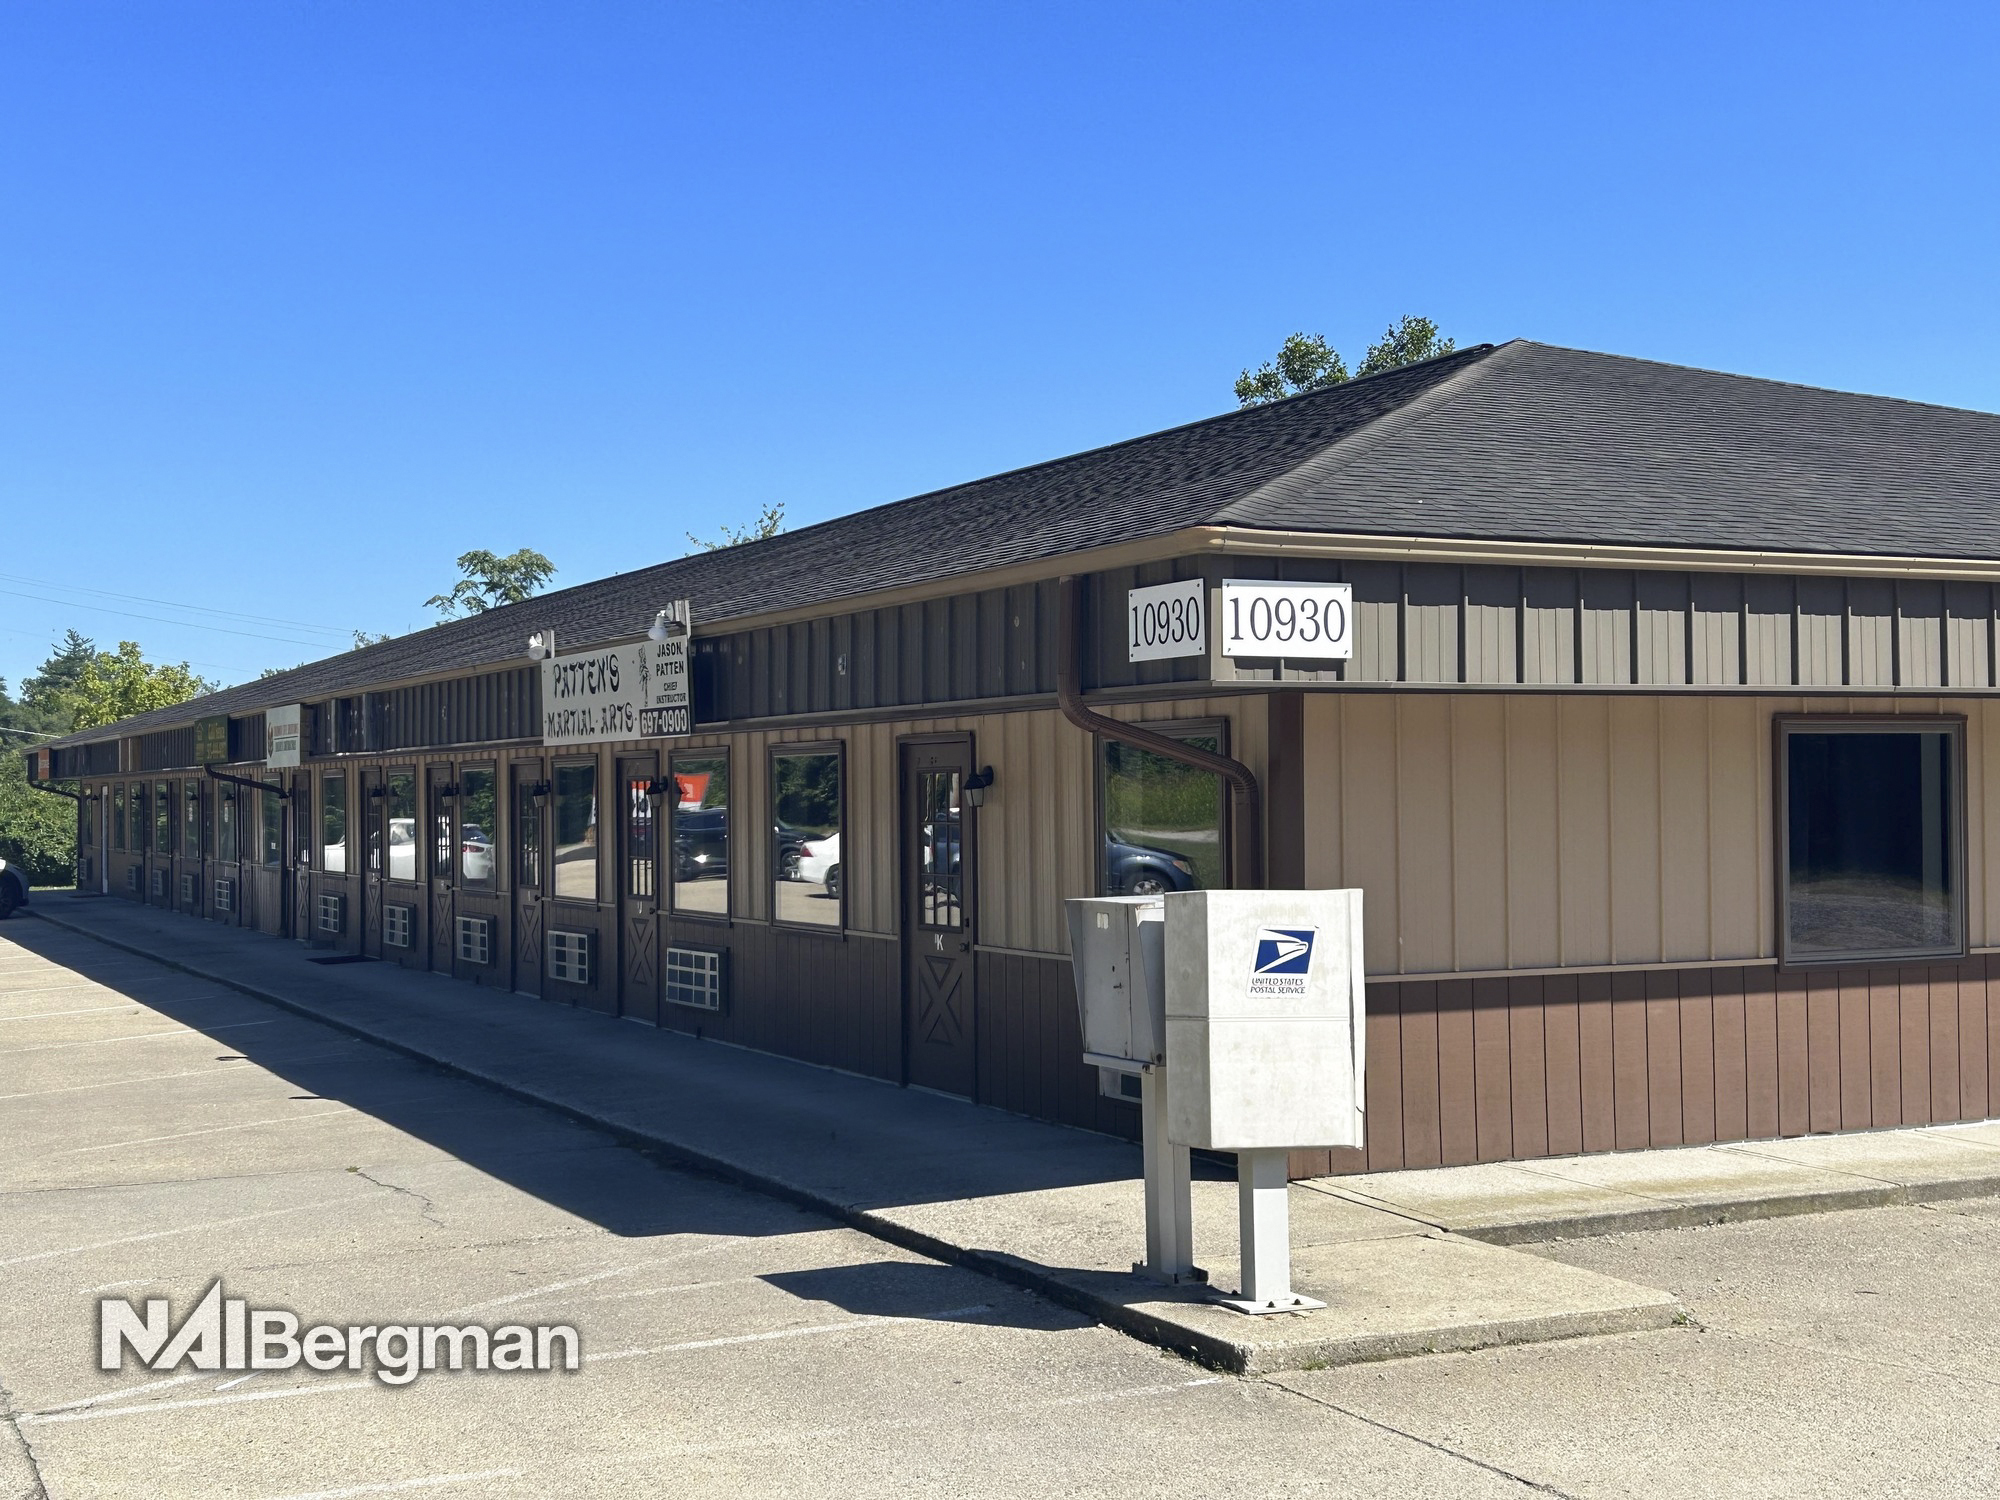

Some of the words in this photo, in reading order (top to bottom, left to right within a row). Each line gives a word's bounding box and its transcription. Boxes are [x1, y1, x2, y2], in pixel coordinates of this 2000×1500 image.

[1131, 596, 1200, 648] 10930
[1229, 597, 1346, 643] 10930
[657, 641, 683, 658] JASON
[553, 653, 620, 699] PATTEN'S
[656, 660, 684, 677] PATTEN
[656, 692, 687, 705] INSTRUCTOR
[547, 707, 596, 738] MARTIAL
[600, 702, 634, 735] ARTS
[641, 708, 688, 734] 697-0900
[1250, 986, 1276, 994] POSTAL
[1278, 986, 1306, 994] SERVICE
[1252, 978, 1279, 986] UNITED
[1280, 978, 1304, 986] STATES
